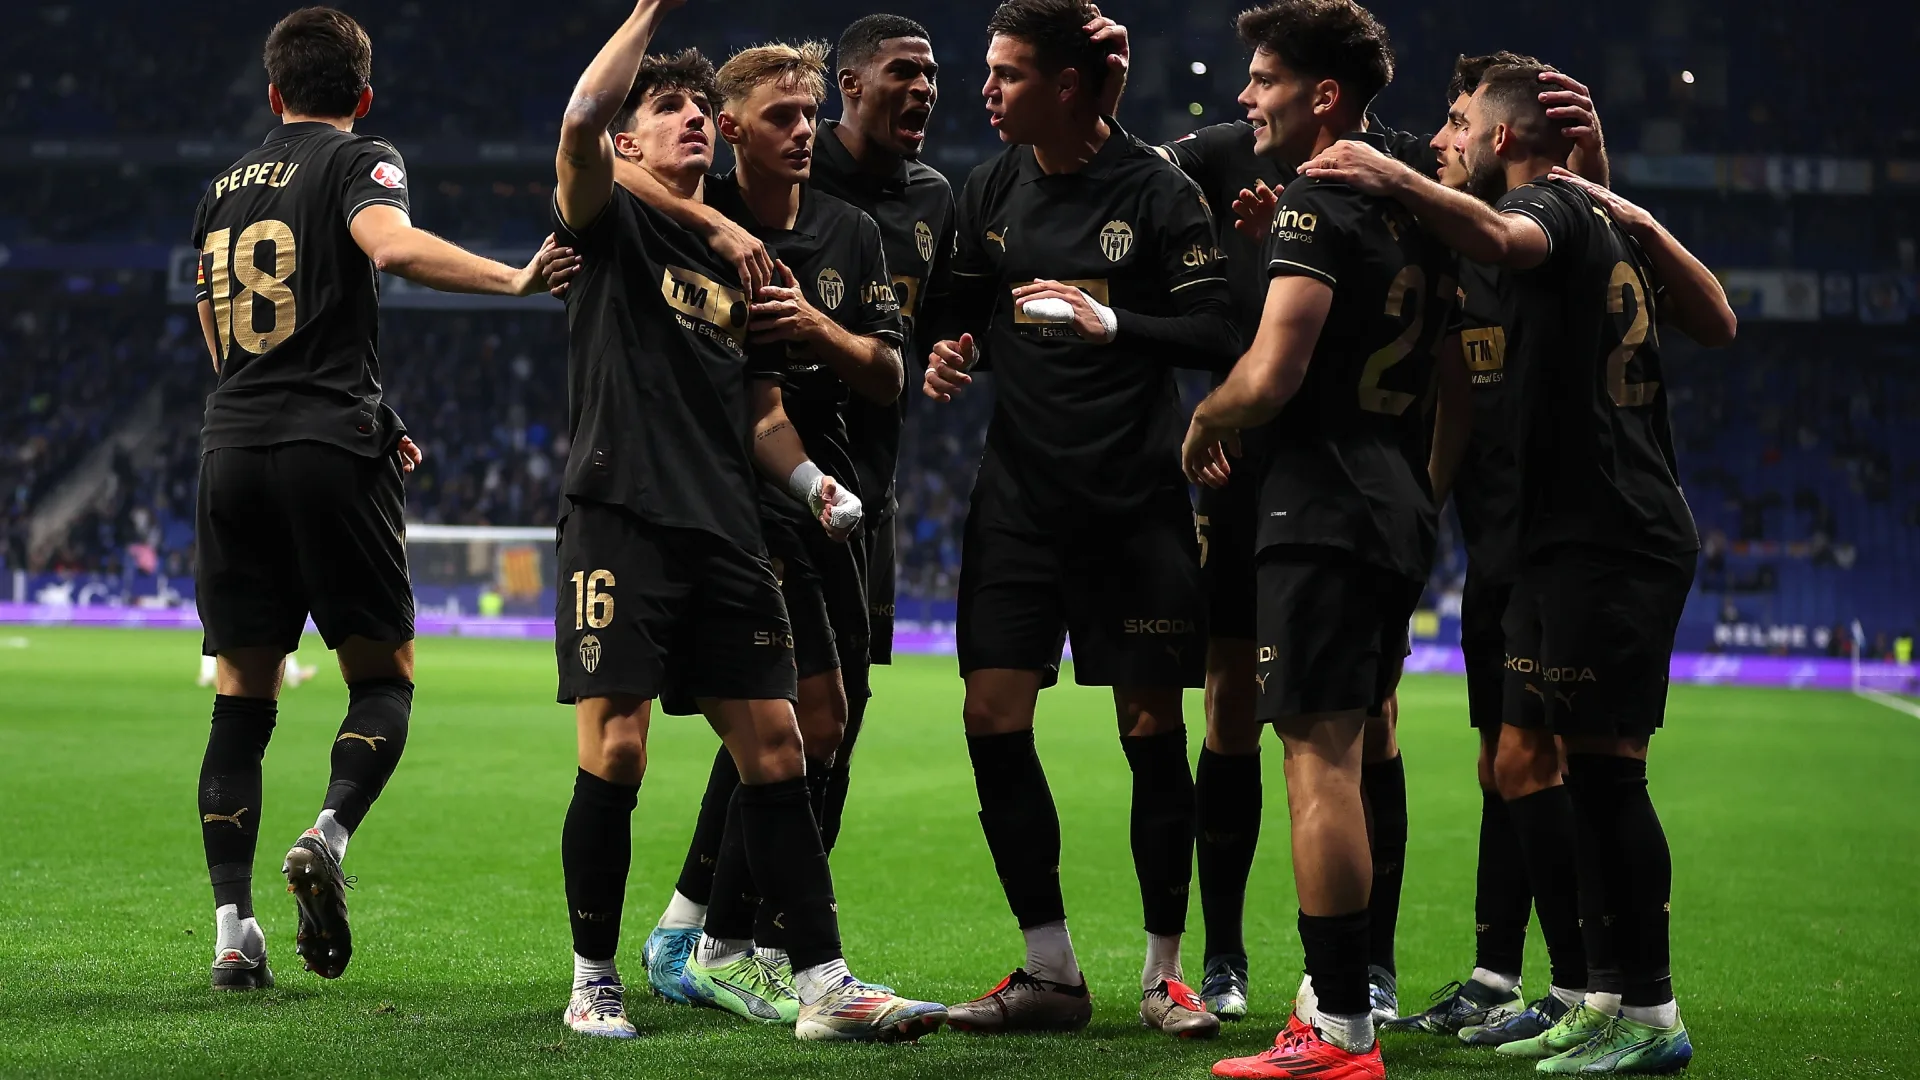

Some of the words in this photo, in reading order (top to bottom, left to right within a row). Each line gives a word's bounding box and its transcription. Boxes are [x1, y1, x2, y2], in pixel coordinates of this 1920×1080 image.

[215, 161, 299, 199] PEPELU
[202, 219, 297, 360] 18
[670, 277, 709, 310] TM
[675, 313, 696, 331] Real
[698, 323, 726, 344] Estate
[1192, 511, 1210, 569] 5
[570, 568, 616, 631] 16
[1123, 618, 1197, 634] SKODA
